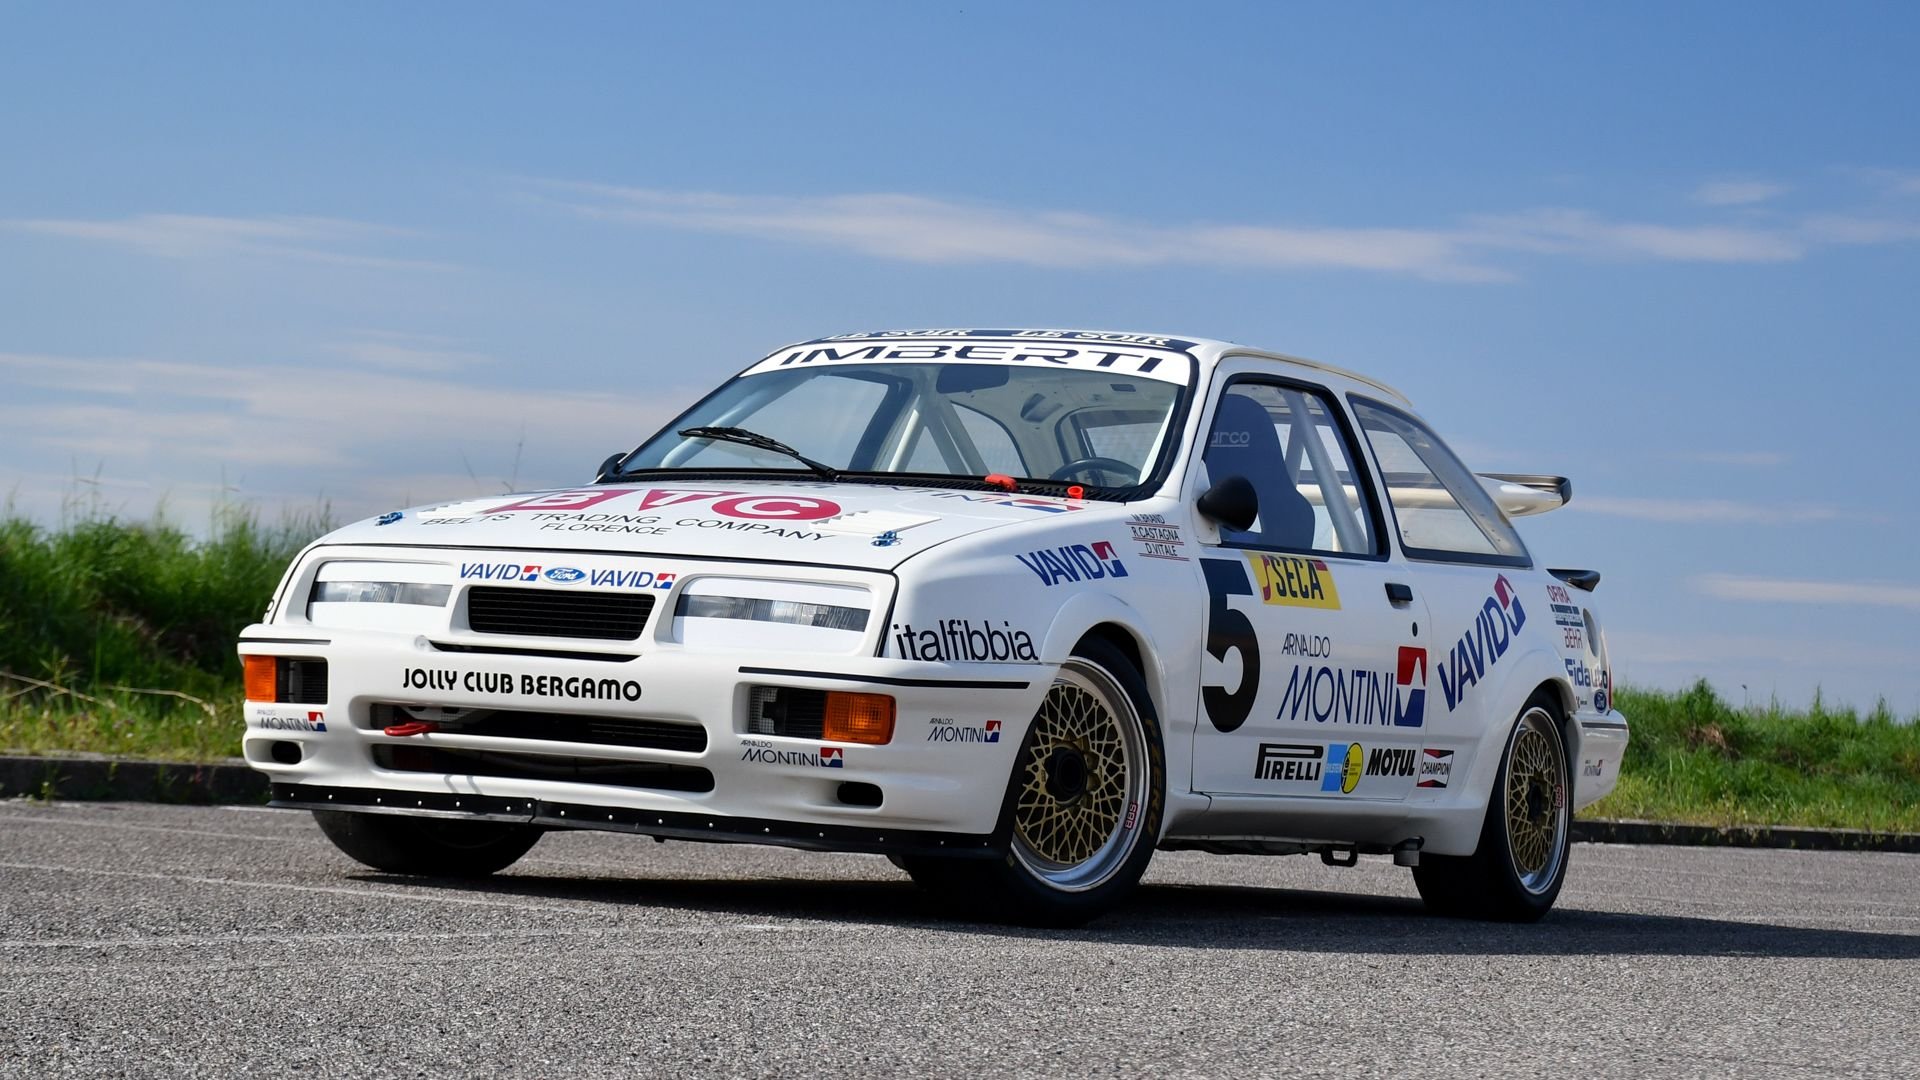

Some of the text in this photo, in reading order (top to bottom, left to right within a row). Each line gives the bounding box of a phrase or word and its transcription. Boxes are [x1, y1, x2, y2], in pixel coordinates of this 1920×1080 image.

[1011, 330, 1170, 346] LE SOIR
[780, 345, 1164, 374] IMBERTI
[1211, 431, 1250, 444] arco
[422, 513, 836, 542] BELTS TRADING COMPANY
[540, 523, 672, 535] FLORENCE
[460, 563, 521, 581] VAVID
[549, 569, 579, 581] Ford
[1015, 544, 1105, 587] VAVID
[590, 569, 654, 588] VAVID
[893, 619, 1039, 662] italfibbia
[1199, 558, 1261, 733] 5
[1281, 633, 1331, 658] ARNALDO
[1437, 596, 1510, 713] VAVID
[403, 668, 642, 701] JOLLY CLUB BERGAMO
[1277, 665, 1394, 726] MONTINI
[260, 717, 311, 731] MONTINI
[927, 726, 985, 743] MONTINI
[740, 739, 773, 749] ARNALDO
[741, 748, 818, 767] MONTINI
[1254, 743, 1324, 781] PIRELLI
[1365, 748, 1416, 777] MOTUL
[1421, 762, 1451, 775] CHAMPION
[1125, 803, 1138, 829] BBS
